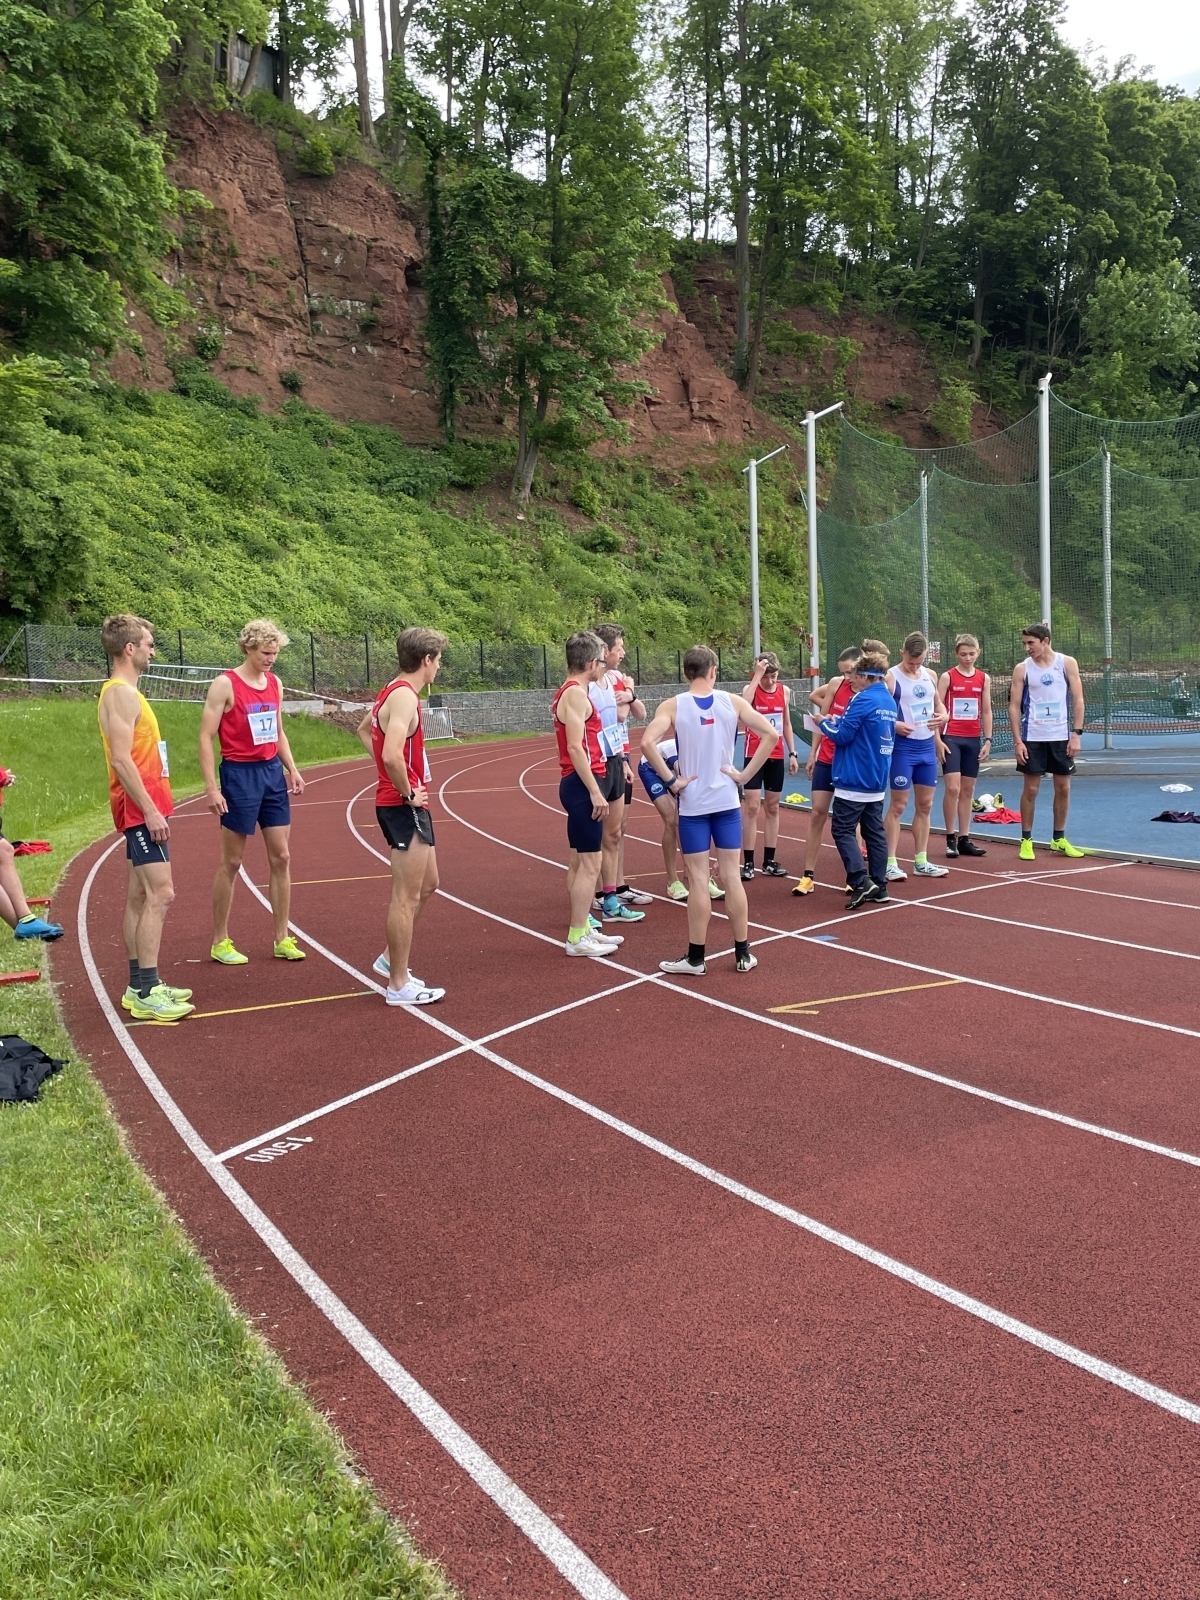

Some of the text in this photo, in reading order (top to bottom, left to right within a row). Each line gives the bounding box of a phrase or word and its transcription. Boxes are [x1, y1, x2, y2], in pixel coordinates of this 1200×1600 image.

[921, 706, 928, 717] 4
[963, 702, 970, 712] 2
[1045, 706, 1052, 717] 1
[259, 717, 273, 732] 17
[243, 1136, 314, 1163] 1500
